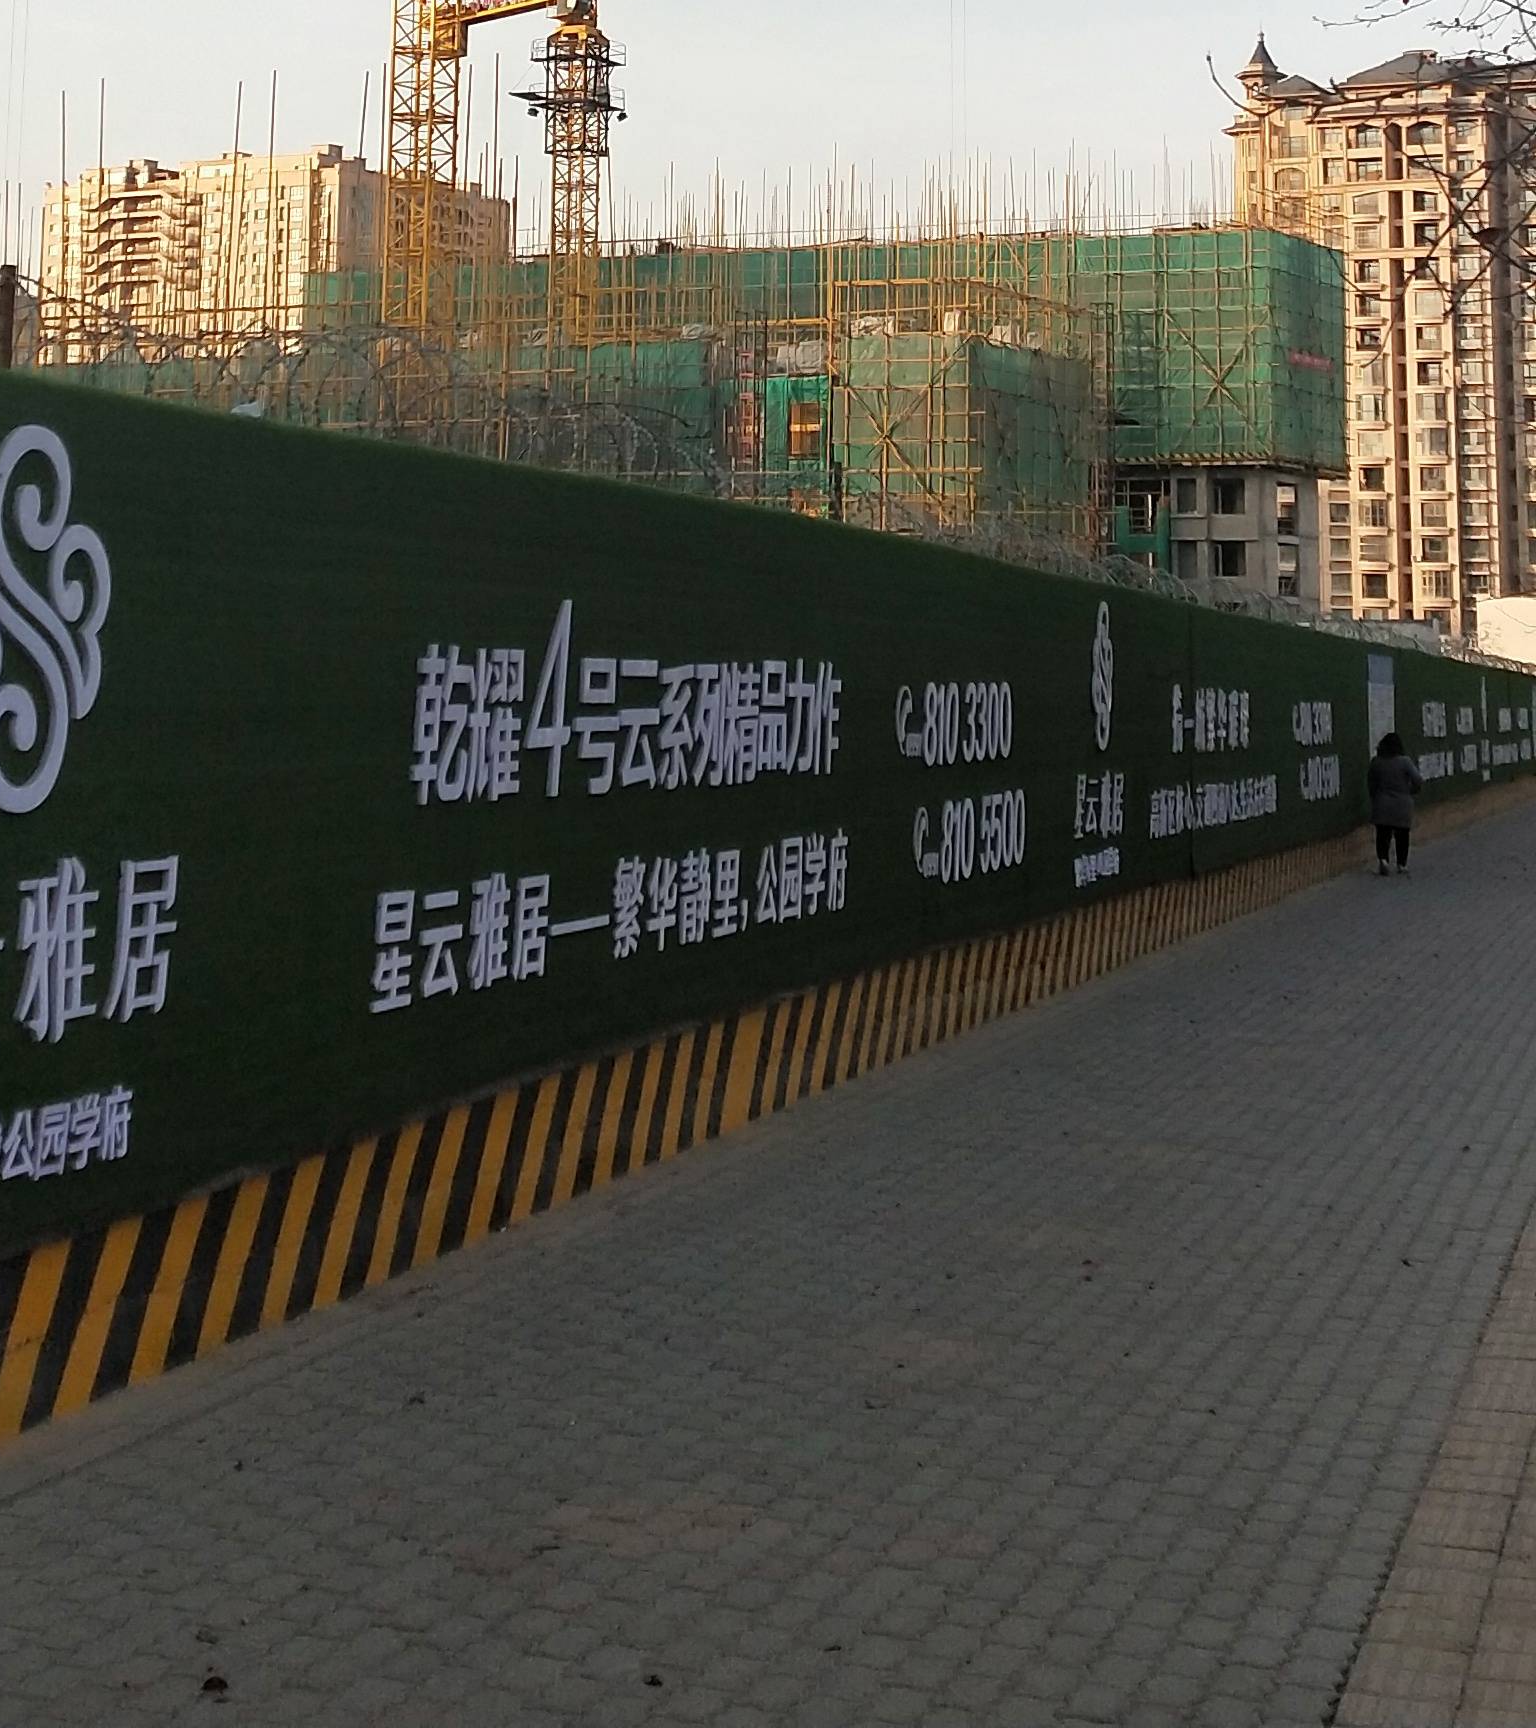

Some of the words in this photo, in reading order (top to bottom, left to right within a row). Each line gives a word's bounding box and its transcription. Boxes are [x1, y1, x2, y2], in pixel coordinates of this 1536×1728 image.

[923, 681, 960, 767] 810
[962, 681, 1012, 763] 3300
[941, 797, 975, 884] 810
[980, 789, 1026, 874] 5500
